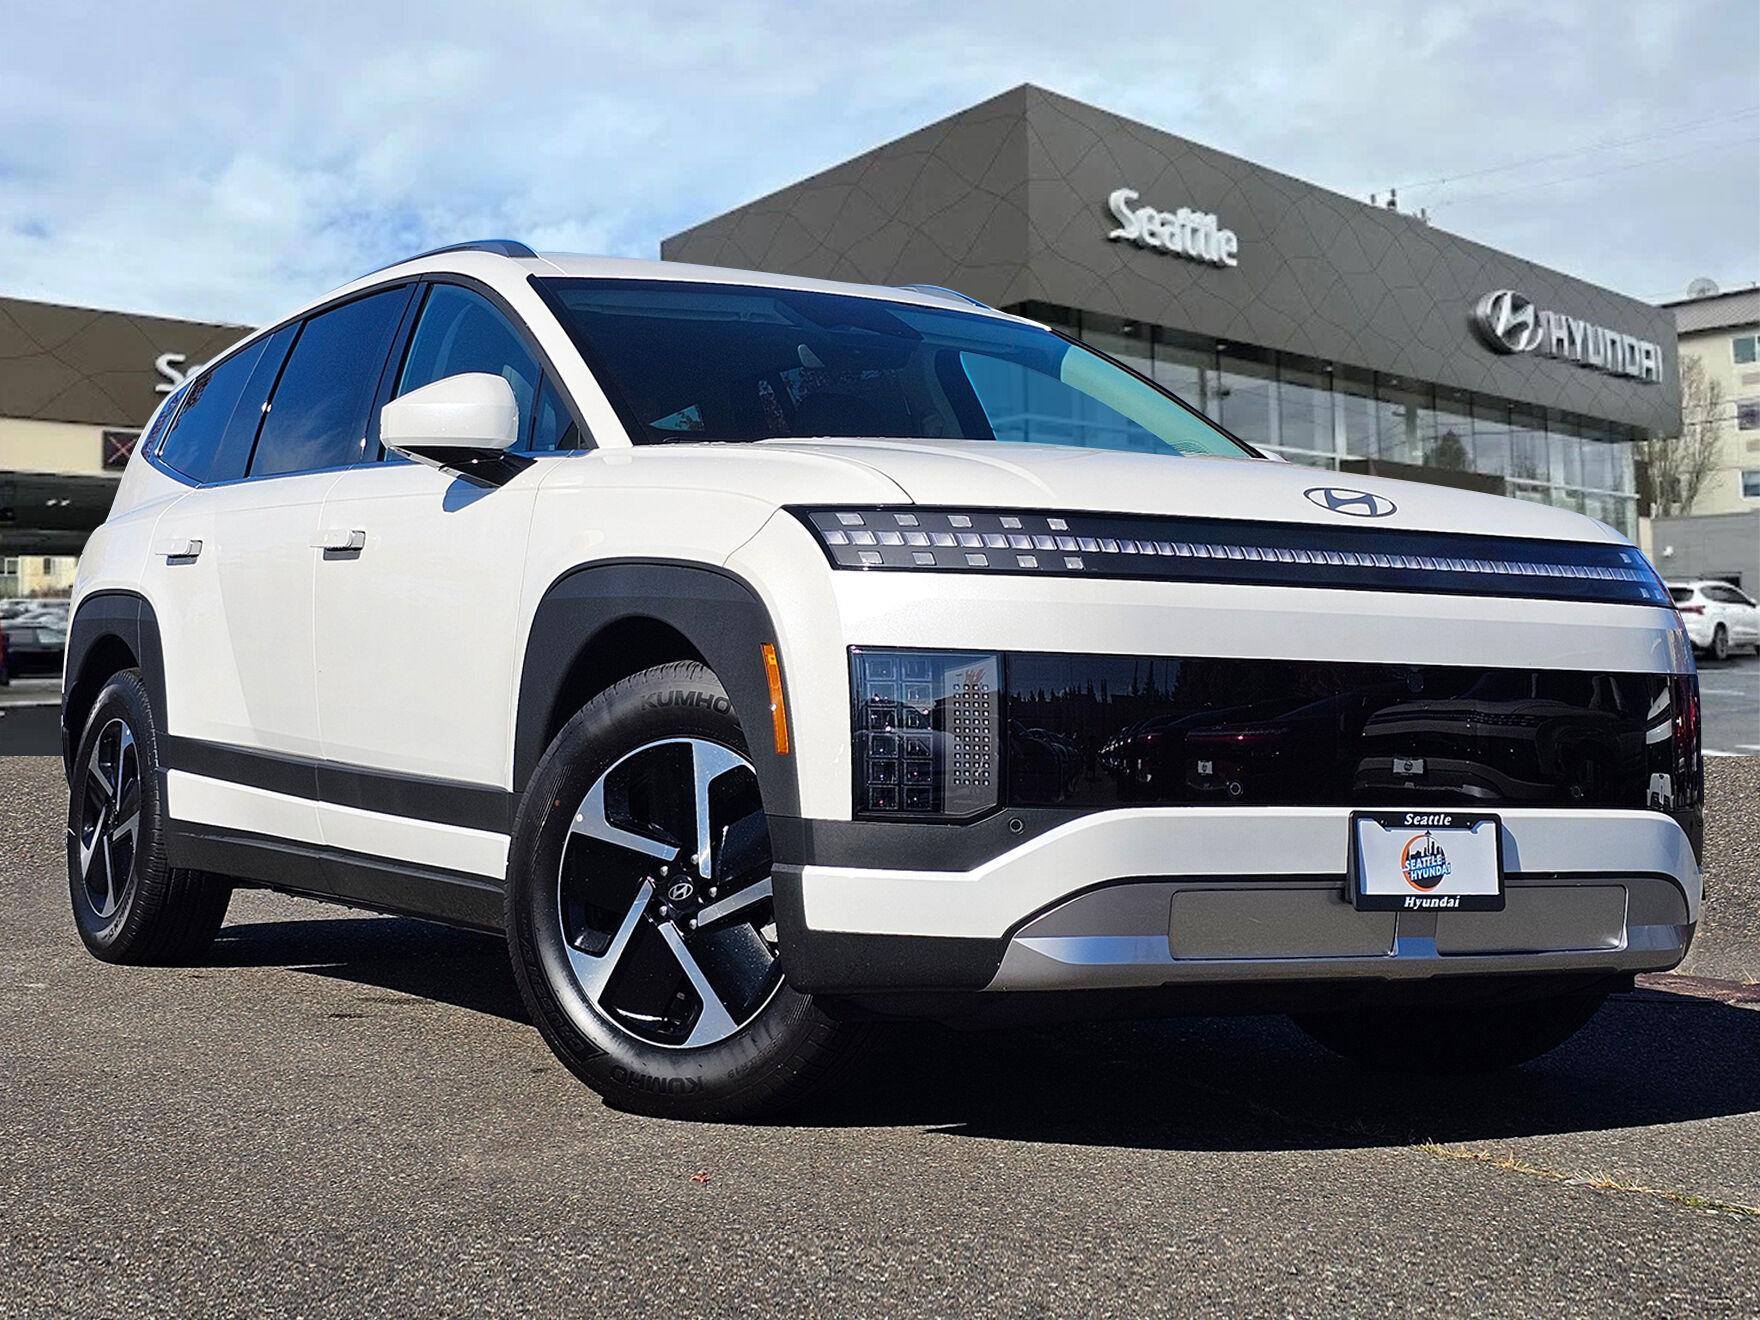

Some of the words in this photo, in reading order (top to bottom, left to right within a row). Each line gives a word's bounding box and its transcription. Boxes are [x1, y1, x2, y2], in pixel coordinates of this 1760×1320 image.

[1108, 188, 1238, 266] Seattle
[1539, 311, 1663, 382] HYUNDAI
[641, 690, 731, 715] KUMHO
[1404, 813, 1452, 826] Seattle
[1405, 854, 1442, 870] SEATTLE
[1410, 861, 1452, 880] HYUNDAI
[1404, 896, 1460, 909] Hyundai
